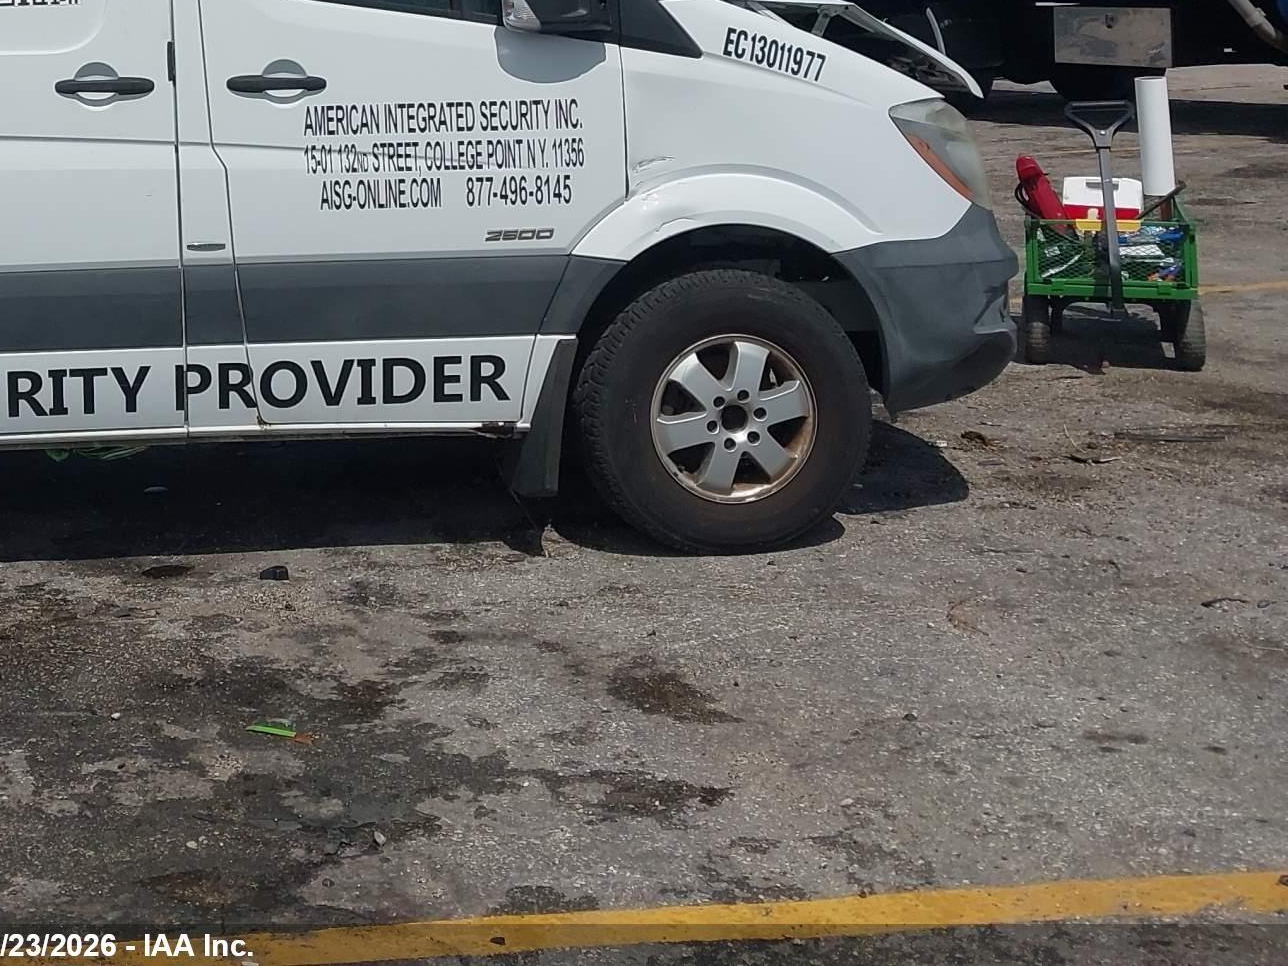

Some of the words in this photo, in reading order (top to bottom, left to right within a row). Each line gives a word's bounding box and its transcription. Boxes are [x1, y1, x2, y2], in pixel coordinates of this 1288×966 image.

[722, 27, 826, 82] EC13011977
[304, 104, 379, 136] AMERICAN
[384, 101, 475, 134] INTEGRATED
[479, 99, 550, 132] SECURITY
[555, 98, 583, 130] INC.
[304, 143, 333, 174] 15-01
[371, 141, 421, 177] STREET,
[425, 139, 484, 171] COLLEGE
[486, 138, 523, 169] POINT
[552, 137, 585, 168] 11356
[320, 177, 442, 211] AISG-ONLINE.COM
[466, 174, 572, 207] 877-496-8145
[485, 228, 555, 242] 2500
[175, 354, 512, 411] PROVIDER
